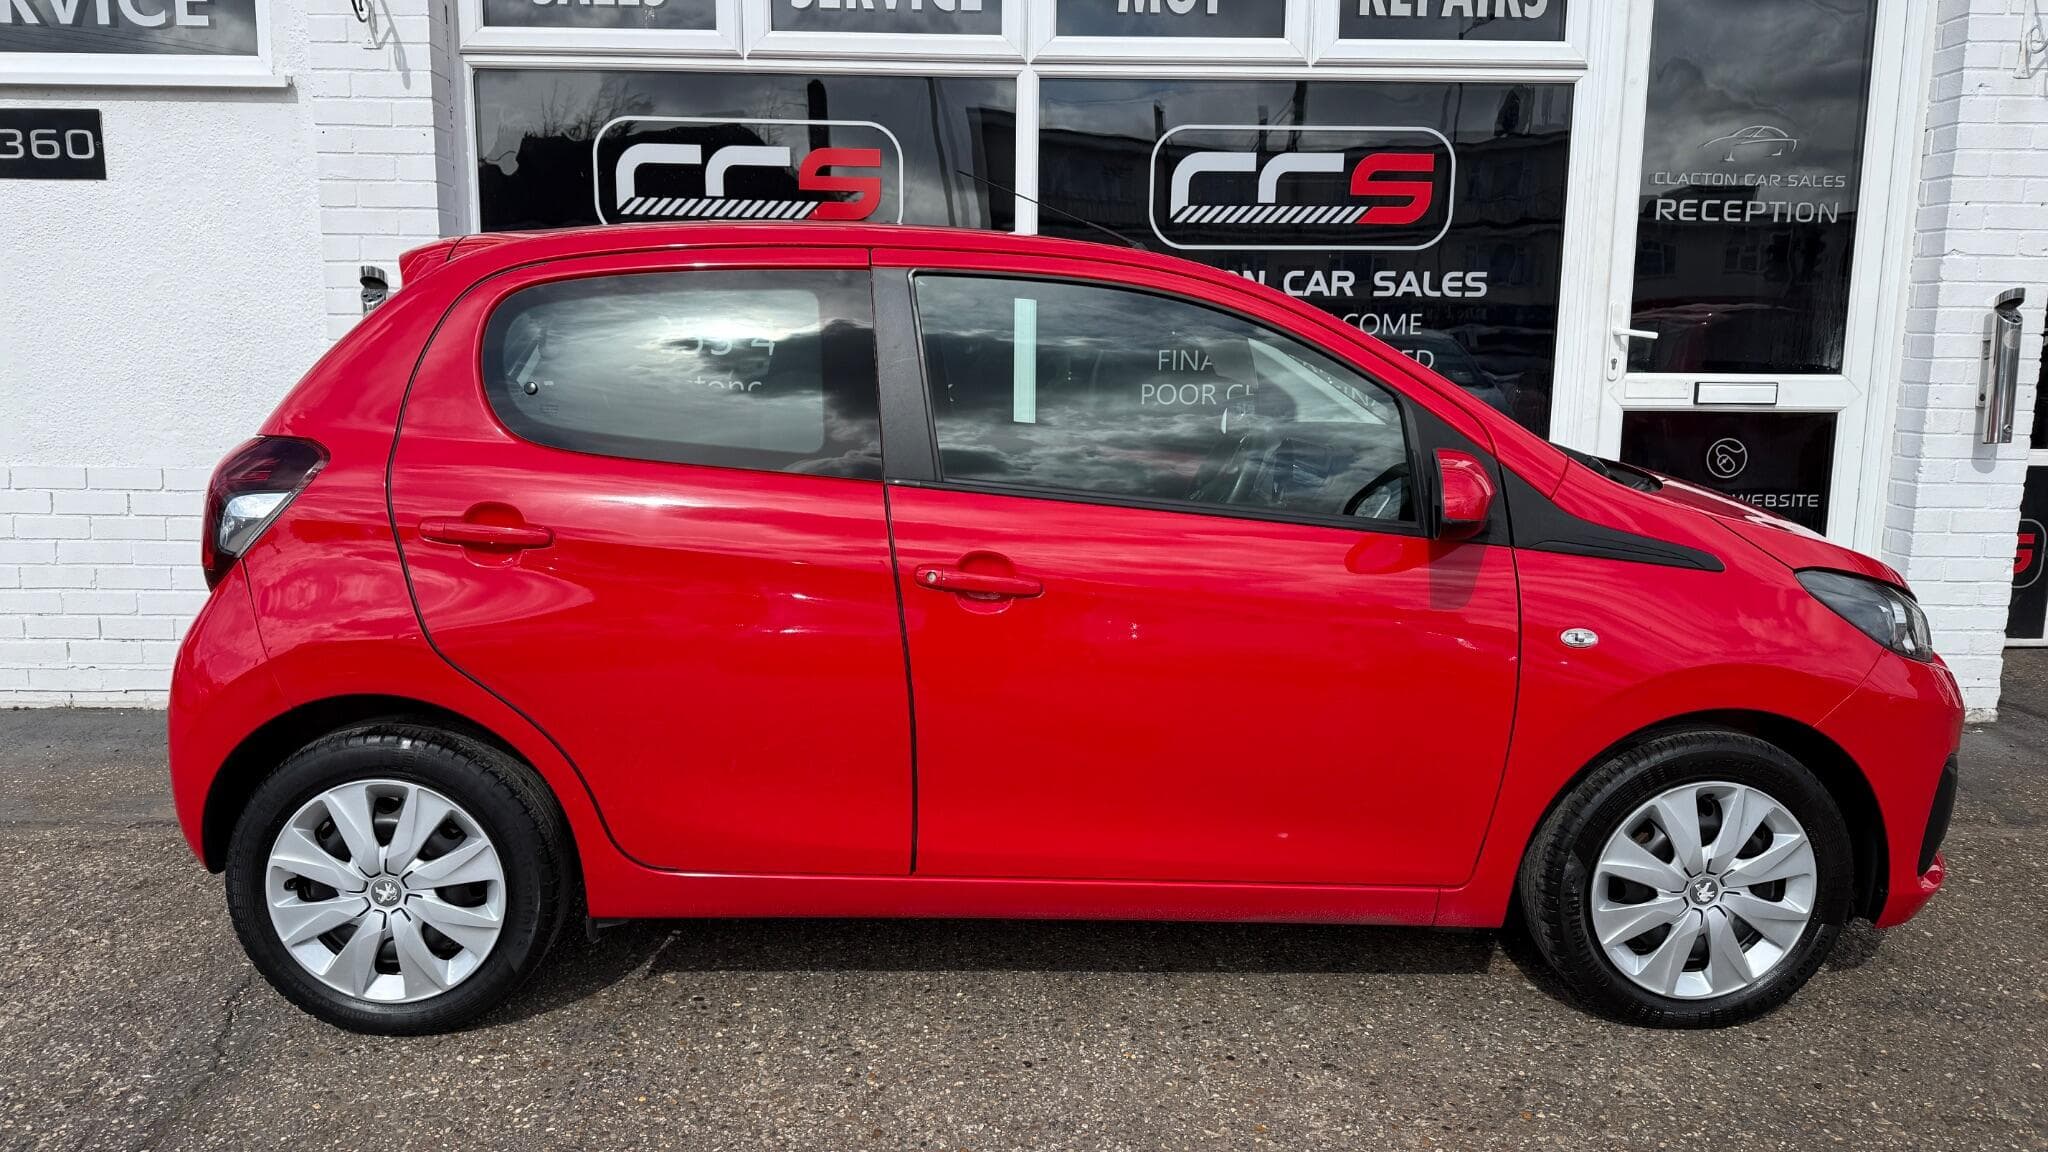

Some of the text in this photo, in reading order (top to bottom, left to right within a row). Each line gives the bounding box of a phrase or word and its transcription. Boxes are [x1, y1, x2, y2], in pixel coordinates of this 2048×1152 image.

[1655, 172, 1846, 187] CLACTON CAR SALES
[1656, 199, 1839, 223] RECEPTION
[1283, 271, 1354, 297] CAR
[1373, 271, 1488, 297] SALES
[1141, 384, 1216, 405] POOR
